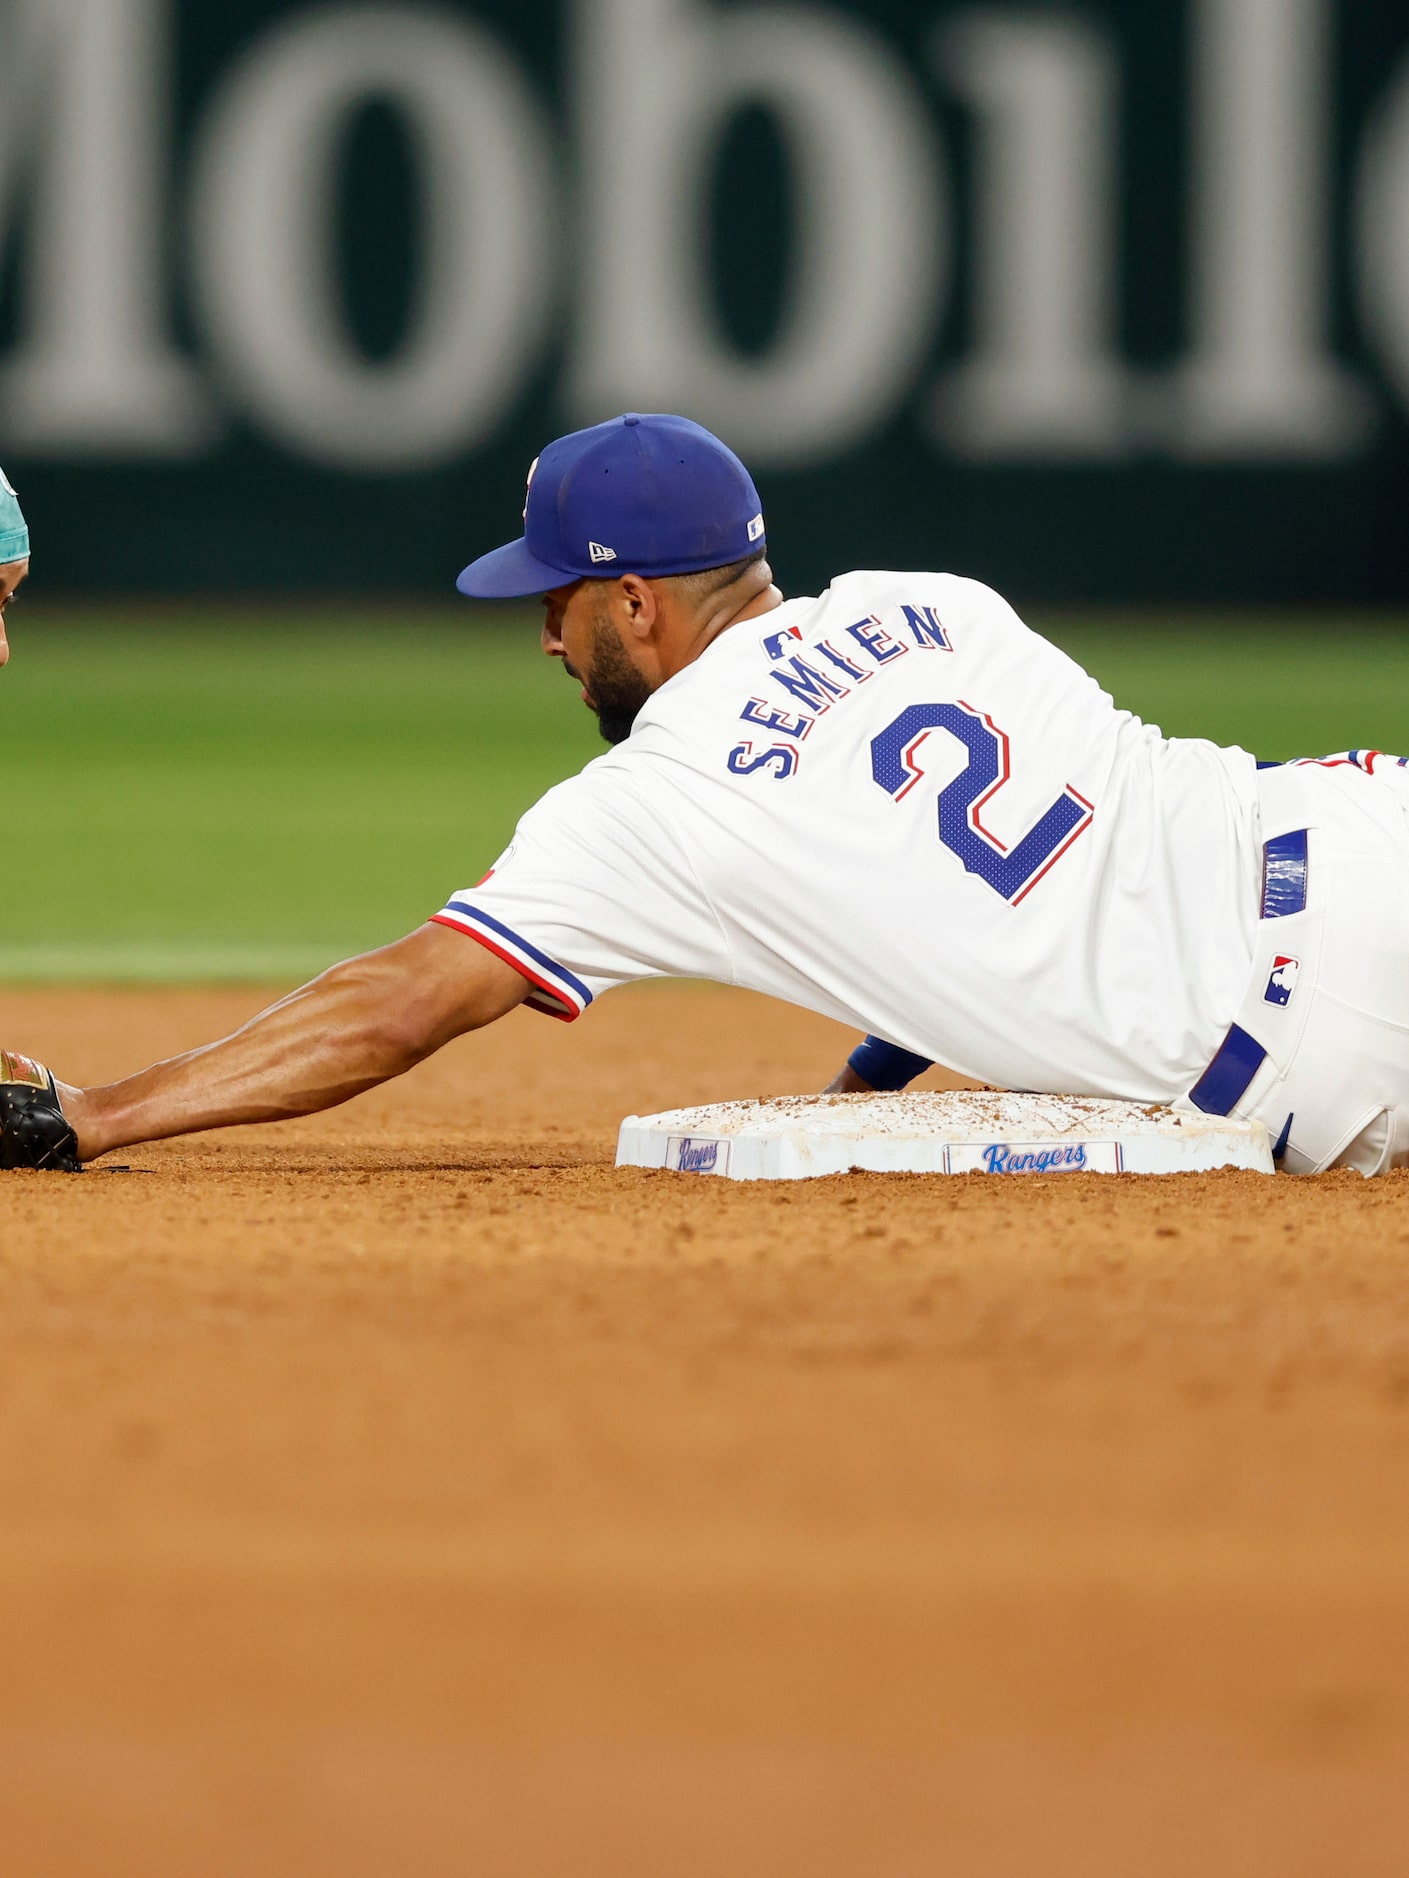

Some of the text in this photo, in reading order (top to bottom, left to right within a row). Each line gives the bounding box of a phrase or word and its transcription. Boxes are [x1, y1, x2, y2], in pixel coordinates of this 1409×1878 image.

[726, 603, 954, 780] SEMIEN
[869, 699, 1095, 908] 2
[678, 1137, 720, 1172] Rangers
[981, 1142, 1088, 1174] Rangers
